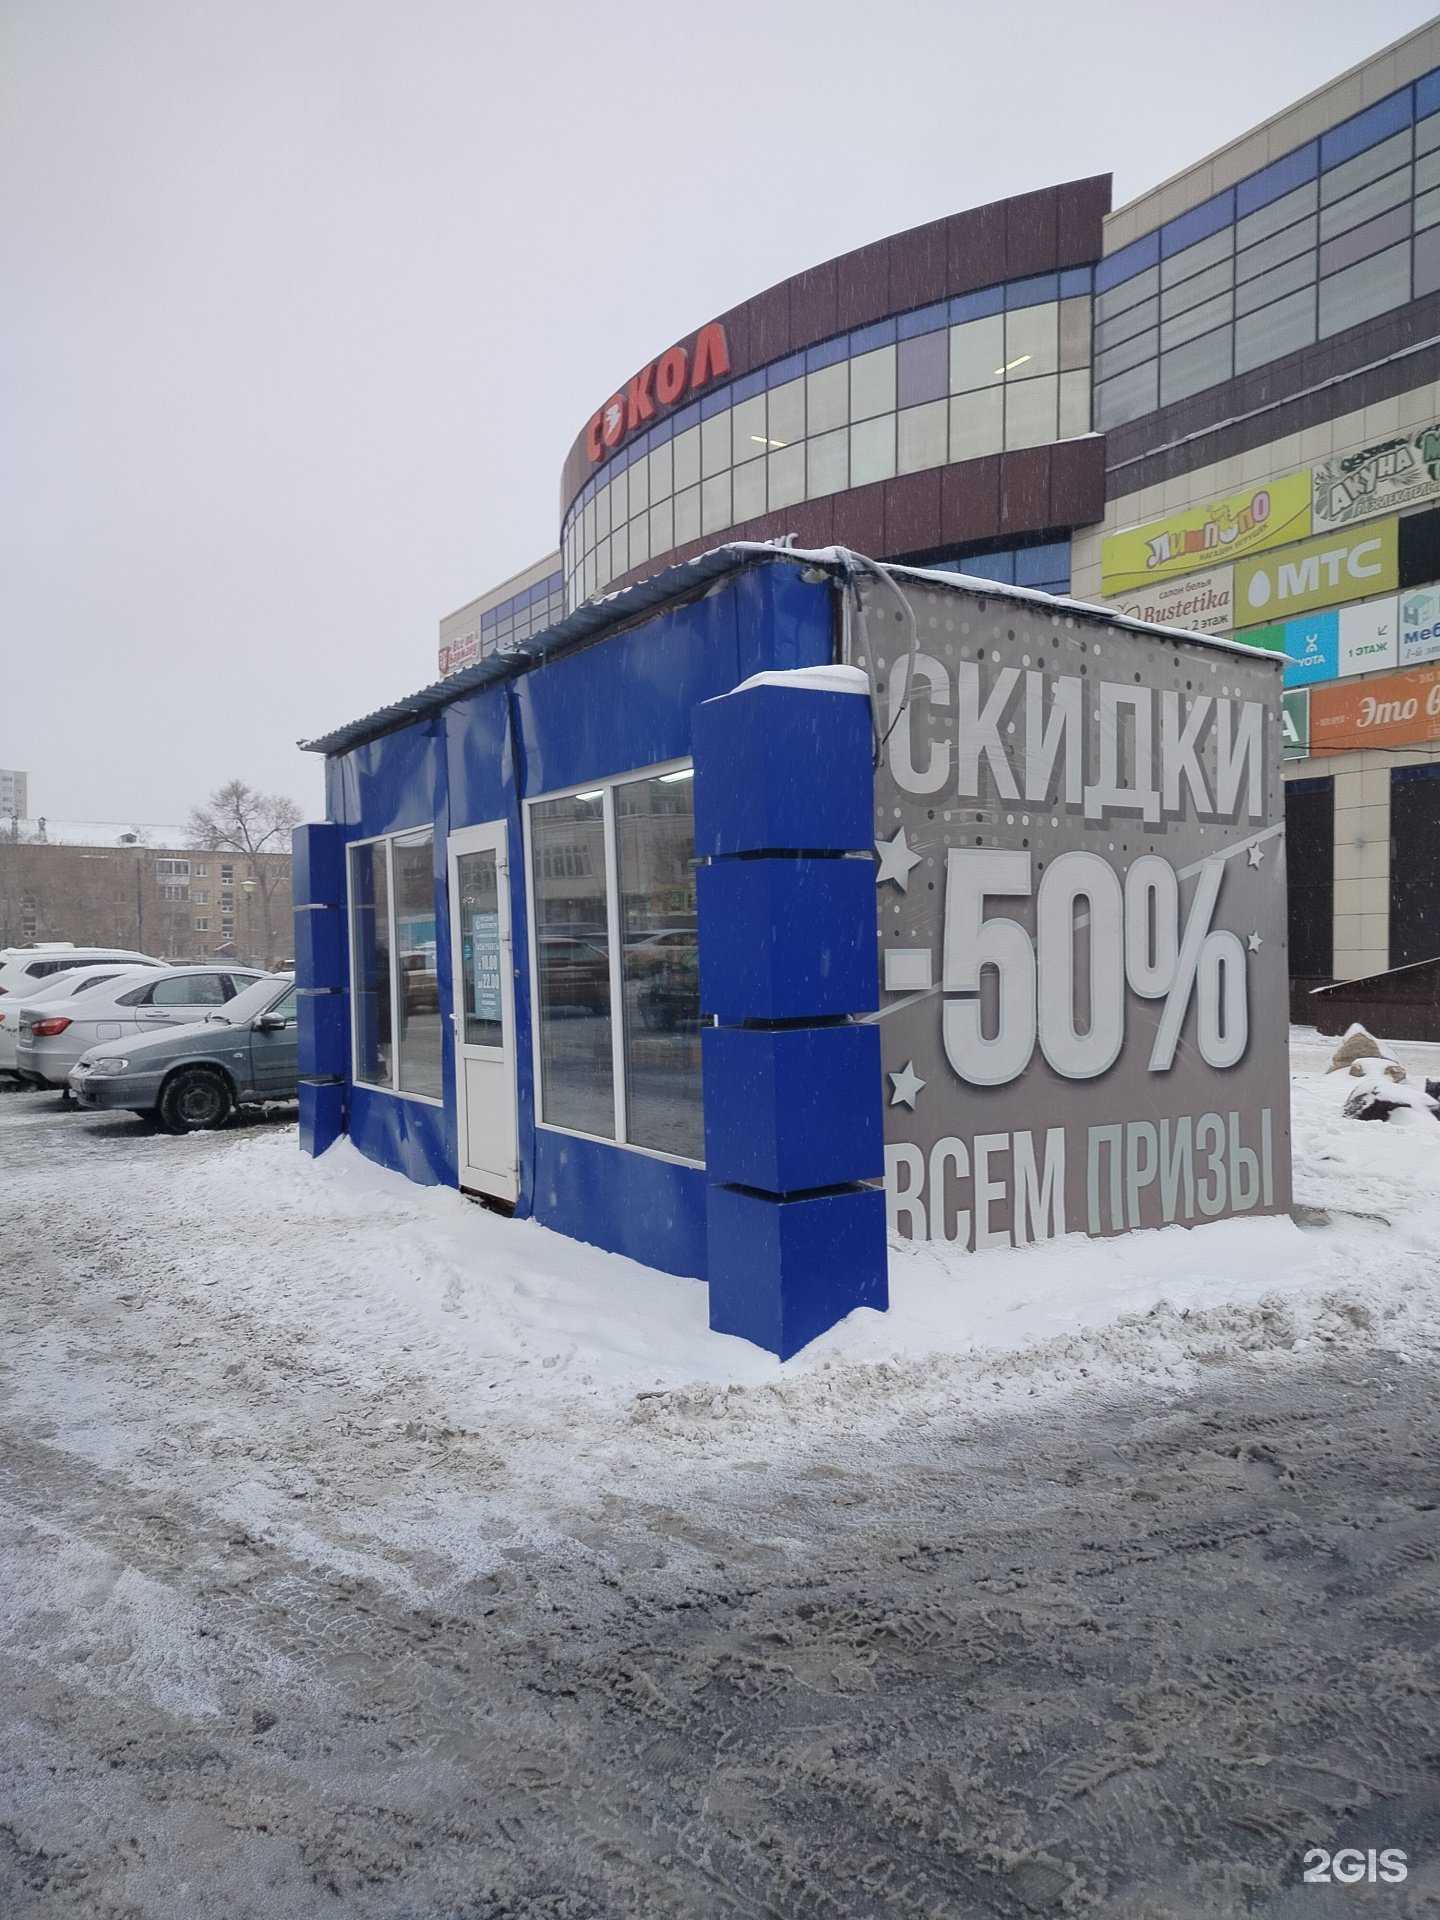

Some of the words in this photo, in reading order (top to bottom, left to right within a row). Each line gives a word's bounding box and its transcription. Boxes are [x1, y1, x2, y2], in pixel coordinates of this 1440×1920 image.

[587, 322, 731, 464] СОКОЛ
[1144, 589, 1230, 623] Bustetika
[1278, 538, 1382, 599] МТС
[1355, 642, 1388, 656] ЭТАЖ
[888, 653, 1263, 823] СКИДКИ
[1356, 696, 1418, 728] Это
[884, 848, 1248, 1086] -50%
[884, 1127, 1066, 1252] ВСЕМ
[1087, 1108, 1273, 1235] ПРИЗЫ
